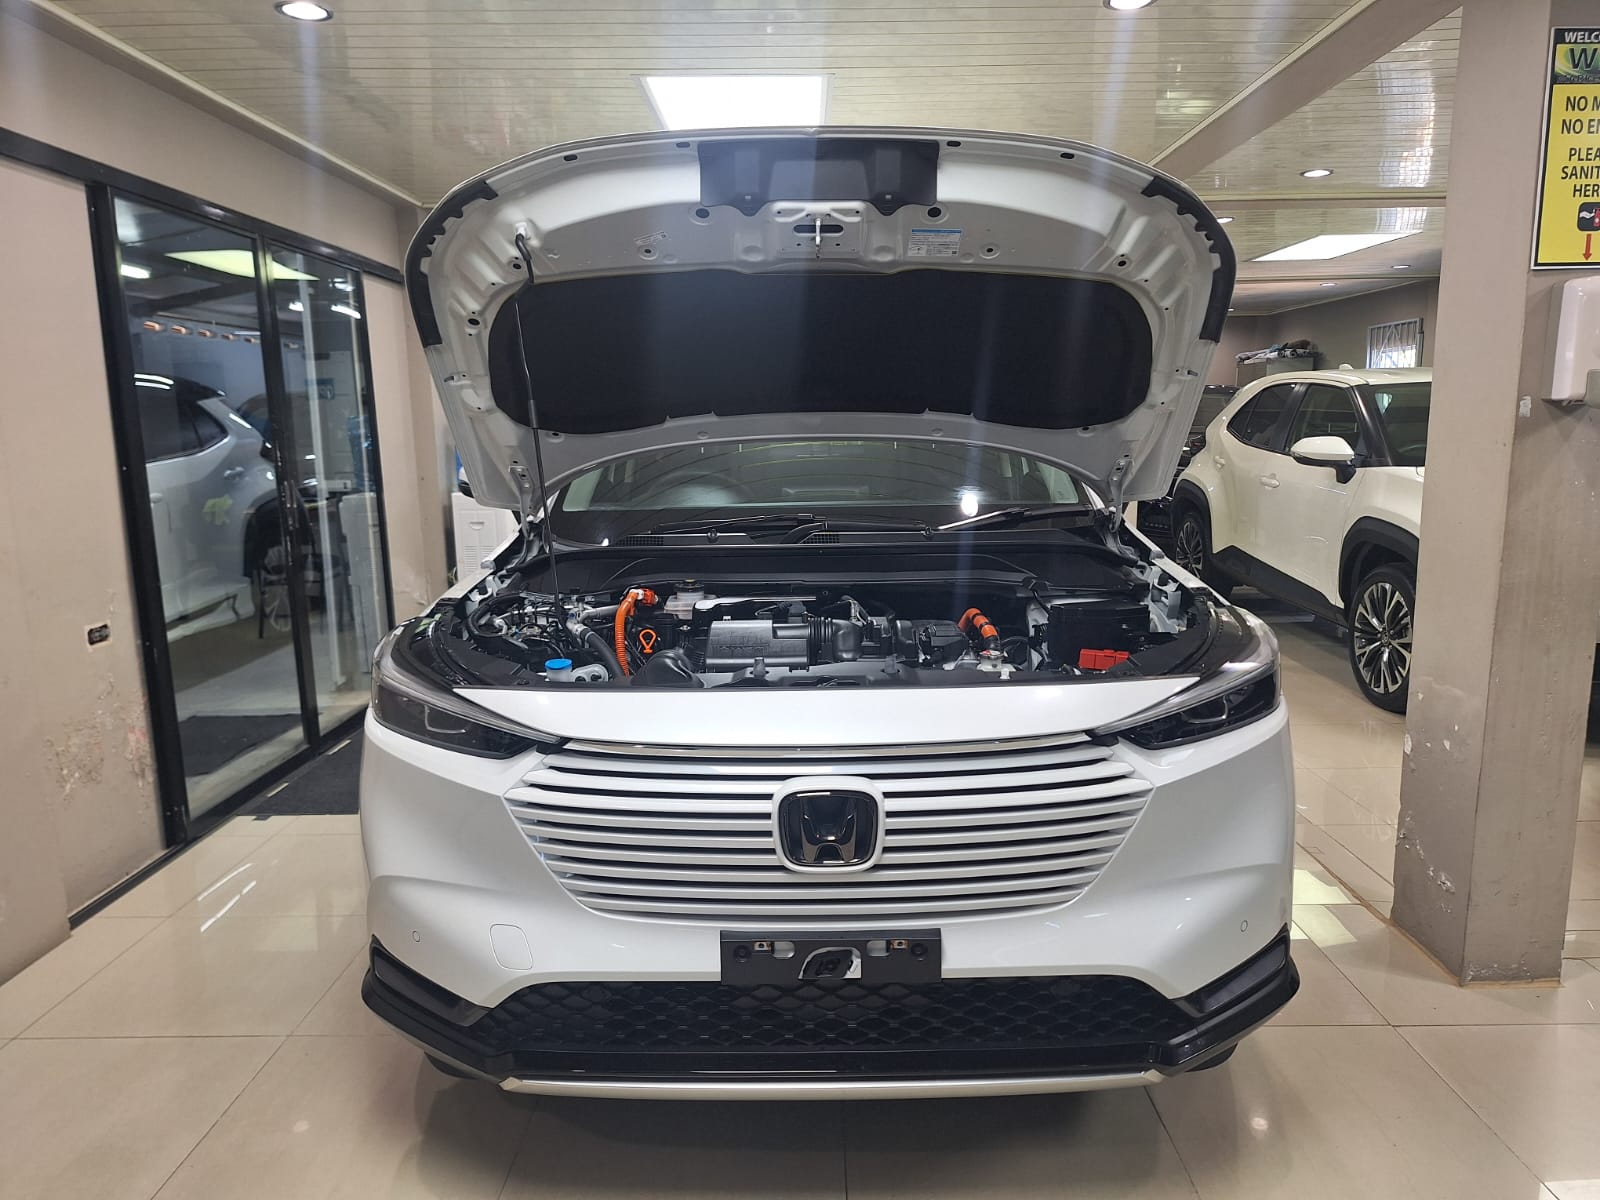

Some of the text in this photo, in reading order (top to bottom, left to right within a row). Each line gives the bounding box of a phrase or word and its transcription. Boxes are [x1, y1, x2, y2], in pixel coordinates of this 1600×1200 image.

[1564, 31, 1600, 43] WELC
[1565, 95, 1588, 111] NO
[1561, 118, 1584, 134] NO
[1568, 147, 1600, 161] PLEA
[1561, 165, 1600, 180] SANIT
[1573, 183, 1600, 198] HER
